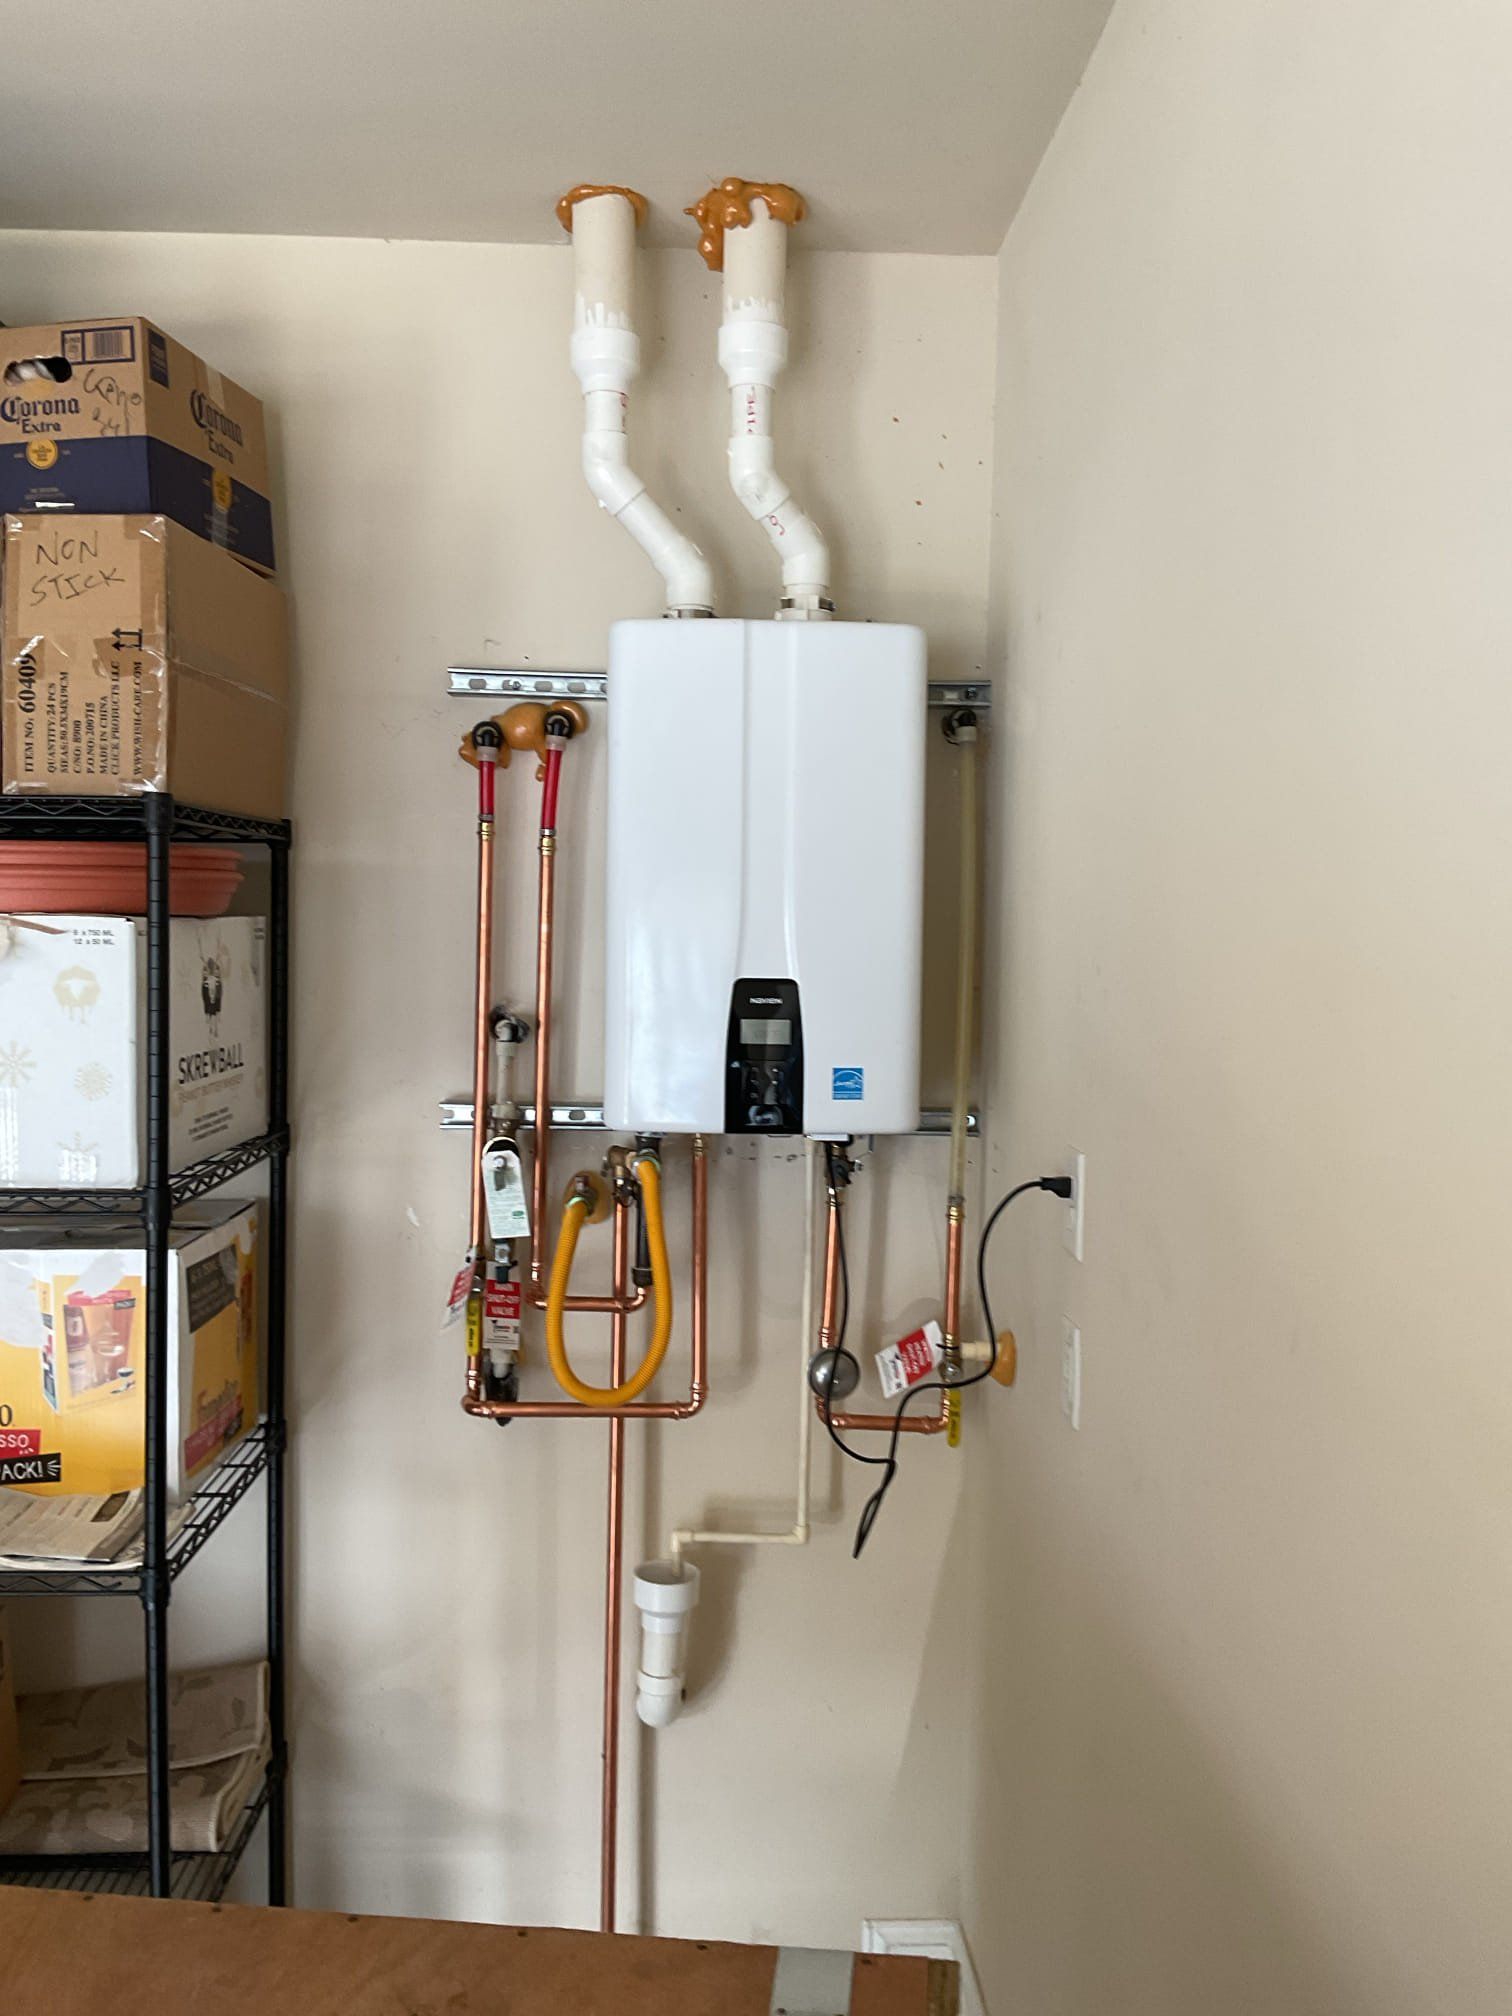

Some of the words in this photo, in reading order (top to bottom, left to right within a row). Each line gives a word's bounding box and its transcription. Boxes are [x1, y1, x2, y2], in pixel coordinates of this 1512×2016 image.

[1, 396, 81, 424] Corona
[21, 418, 62, 434] Extra
[190, 388, 244, 447] Corona
[206, 430, 235, 465] Extra
[35, 530, 99, 566] NON
[30, 567, 126, 607] STICK
[18, 653, 37, 713] 60409
[110, 660, 120, 682] LLC
[24, 718, 34, 739] NO:
[85, 702, 95, 736] 200715
[99, 695, 108, 729] CHINA
[110, 684, 120, 740] PRODUCTS
[99, 730, 108, 742] IN
[24, 742, 34, 773] ITEM
[99, 744, 108, 774] MADE
[110, 743, 120, 775] CLICK
[178, 1043, 244, 1085] SKREWBALL
